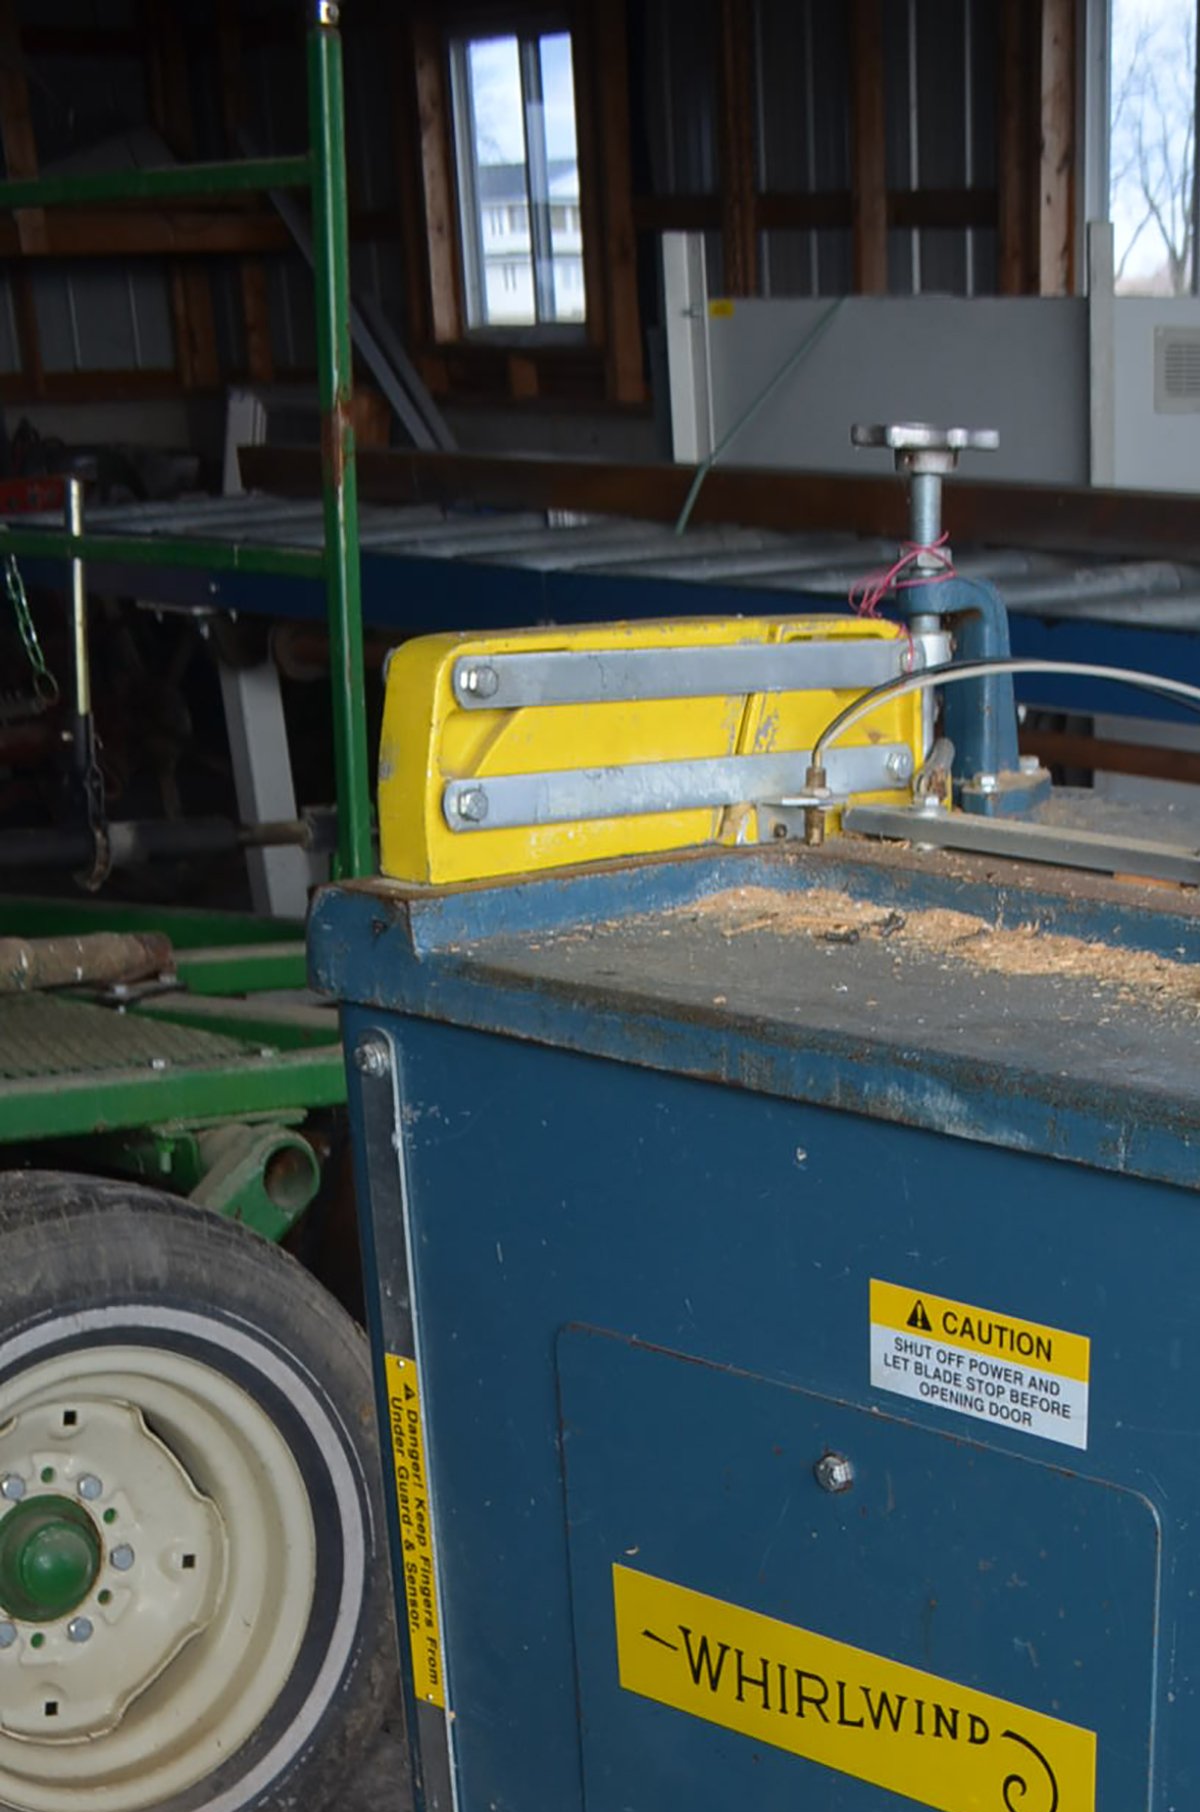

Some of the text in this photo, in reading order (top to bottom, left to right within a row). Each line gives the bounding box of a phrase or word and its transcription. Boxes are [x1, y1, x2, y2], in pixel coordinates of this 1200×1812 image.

[894, 1336, 1060, 1396] SHUT OFF POWER AND
[942, 1312, 1052, 1363] CAUTION
[884, 1352, 1071, 1419] LET BLADE STOP BEFORE
[919, 1381, 1033, 1427] OPENING DOOR
[392, 1396, 421, 1633] Under Guard & Sensor.
[407, 1409, 438, 1686] Danger! Keep Fingers From
[678, 1625, 990, 1746] WHIRLWIND
